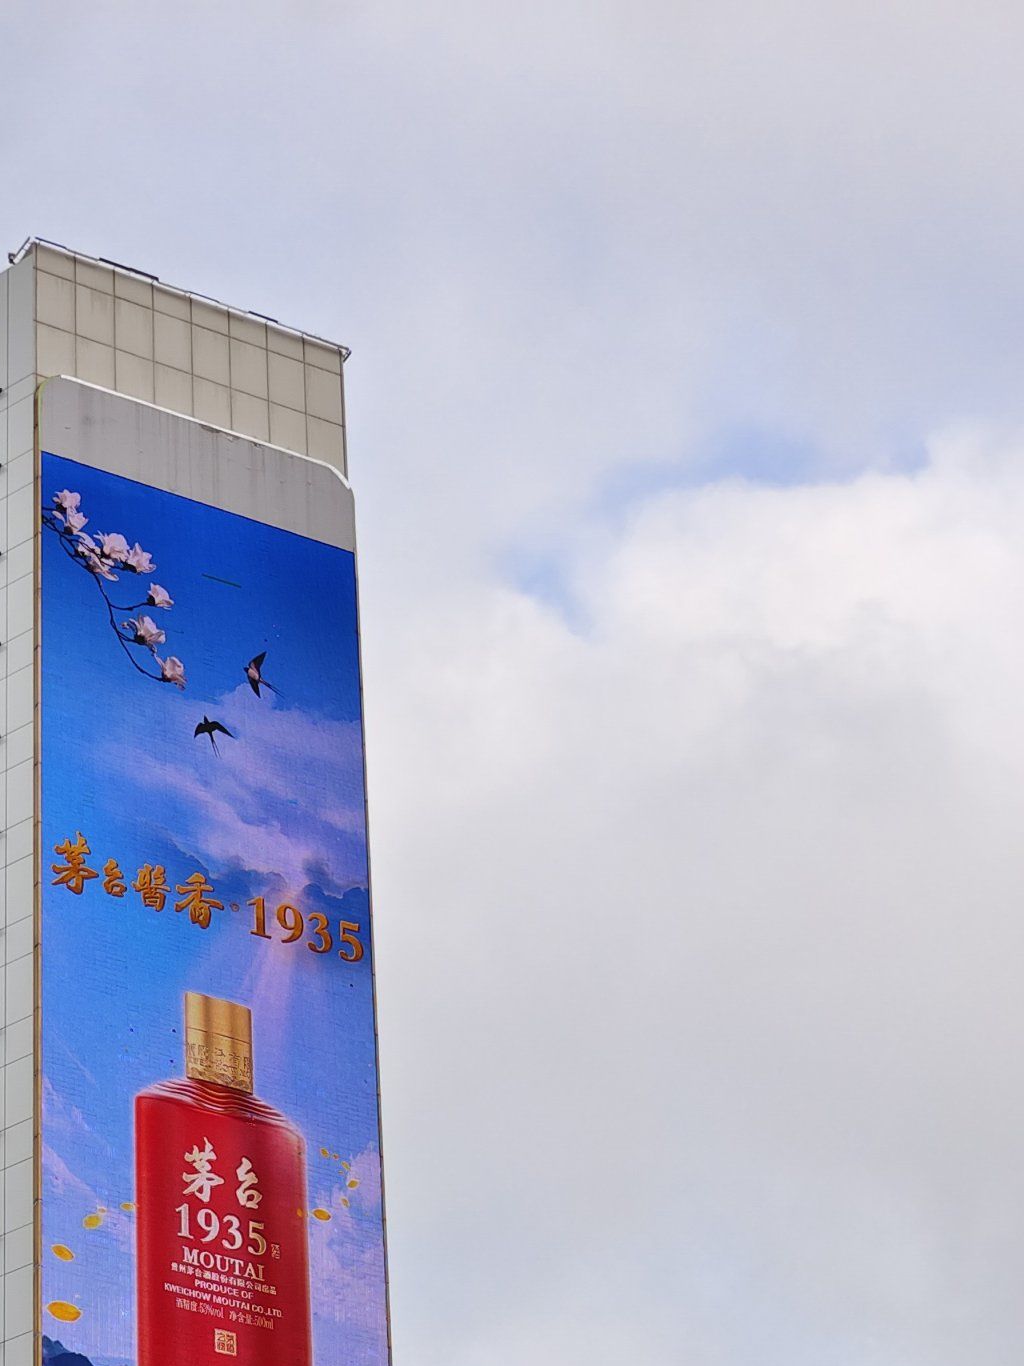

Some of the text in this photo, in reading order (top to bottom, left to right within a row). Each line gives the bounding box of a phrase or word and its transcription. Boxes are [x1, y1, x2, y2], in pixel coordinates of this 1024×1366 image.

[182, 1136, 263, 1210] 茅台
[175, 1203, 267, 1256] 1935
[182, 1246, 266, 1282] MOUTAI
[164, 1282, 211, 1303] KWEICHOW
[212, 1295, 250, 1312] MOUTAI
[194, 1279, 254, 1300] PRODUCE OF
